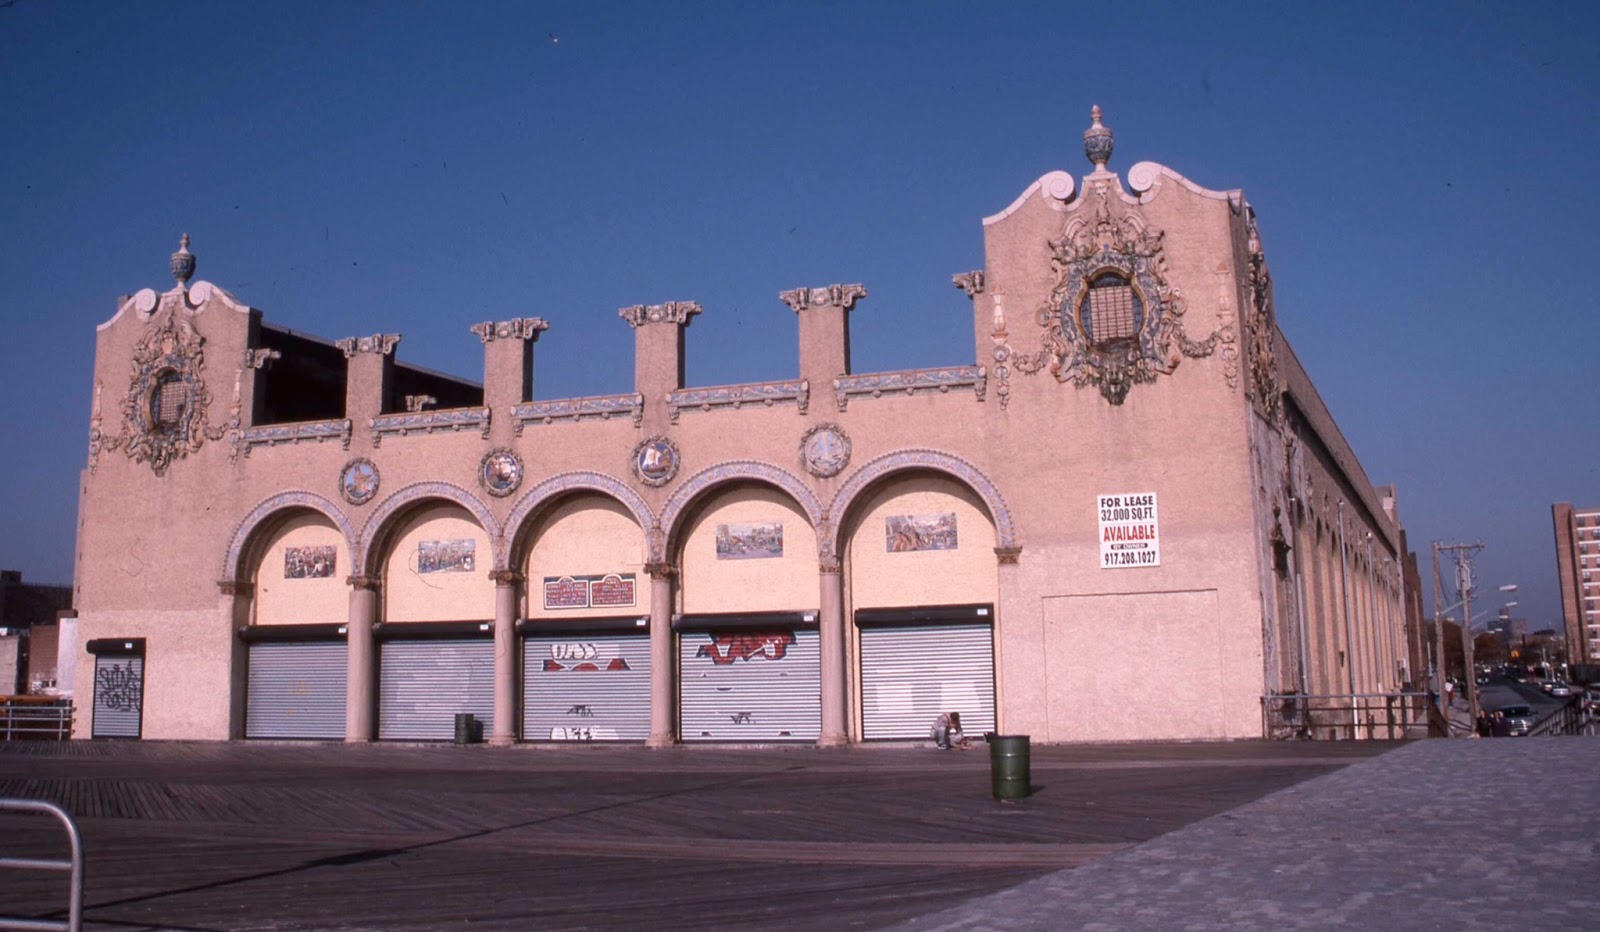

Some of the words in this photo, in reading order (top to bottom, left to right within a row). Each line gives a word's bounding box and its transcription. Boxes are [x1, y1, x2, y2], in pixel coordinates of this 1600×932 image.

[1101, 498, 1121, 508] FOR
[1124, 496, 1153, 506] LEASE
[1101, 508, 1130, 521] 32,000
[1131, 507, 1154, 520] SQ.FT.
[1104, 525, 1155, 541] AVAILABLE
[1105, 551, 1156, 565] 917.208.1027
